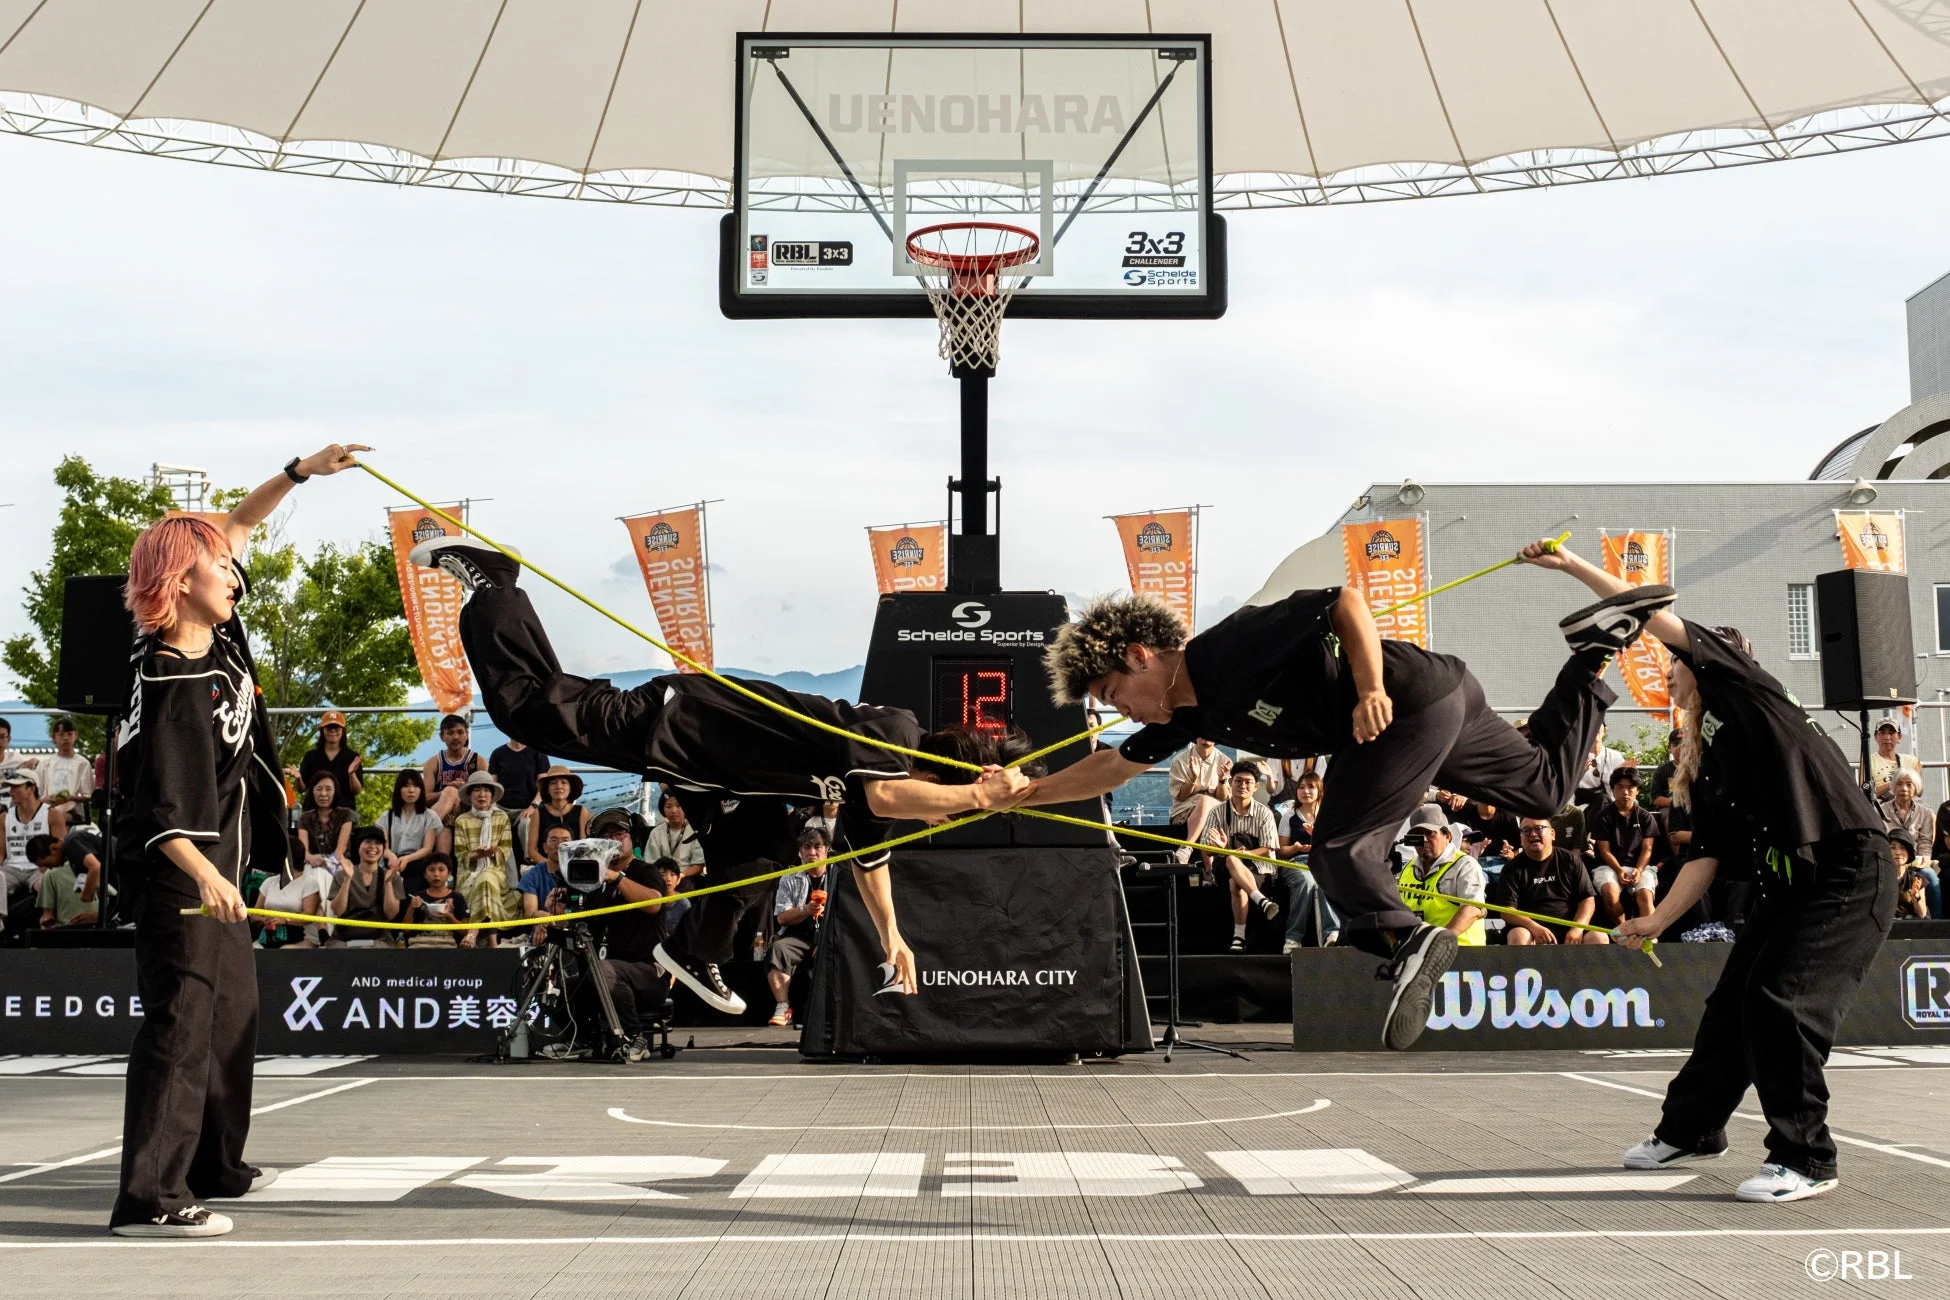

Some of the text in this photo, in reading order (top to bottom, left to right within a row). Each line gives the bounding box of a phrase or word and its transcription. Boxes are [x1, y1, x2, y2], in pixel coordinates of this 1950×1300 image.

[828, 93, 1126, 134] UENOHARA
[1125, 231, 1186, 254] 3x3
[776, 244, 817, 259] RBL
[1147, 269, 1197, 278] Schelde
[1147, 277, 1197, 287] Sports
[897, 629, 1045, 644] Schelde Sports
[963, 671, 1006, 729] 12
[351, 976, 483, 990] AND medical group
[922, 970, 1078, 986] UENOHARA CITY
[5, 995, 145, 1018] EEDGE
[1425, 967, 1655, 1031] Wilson
[1916, 1010, 1942, 1018] ROYAL
